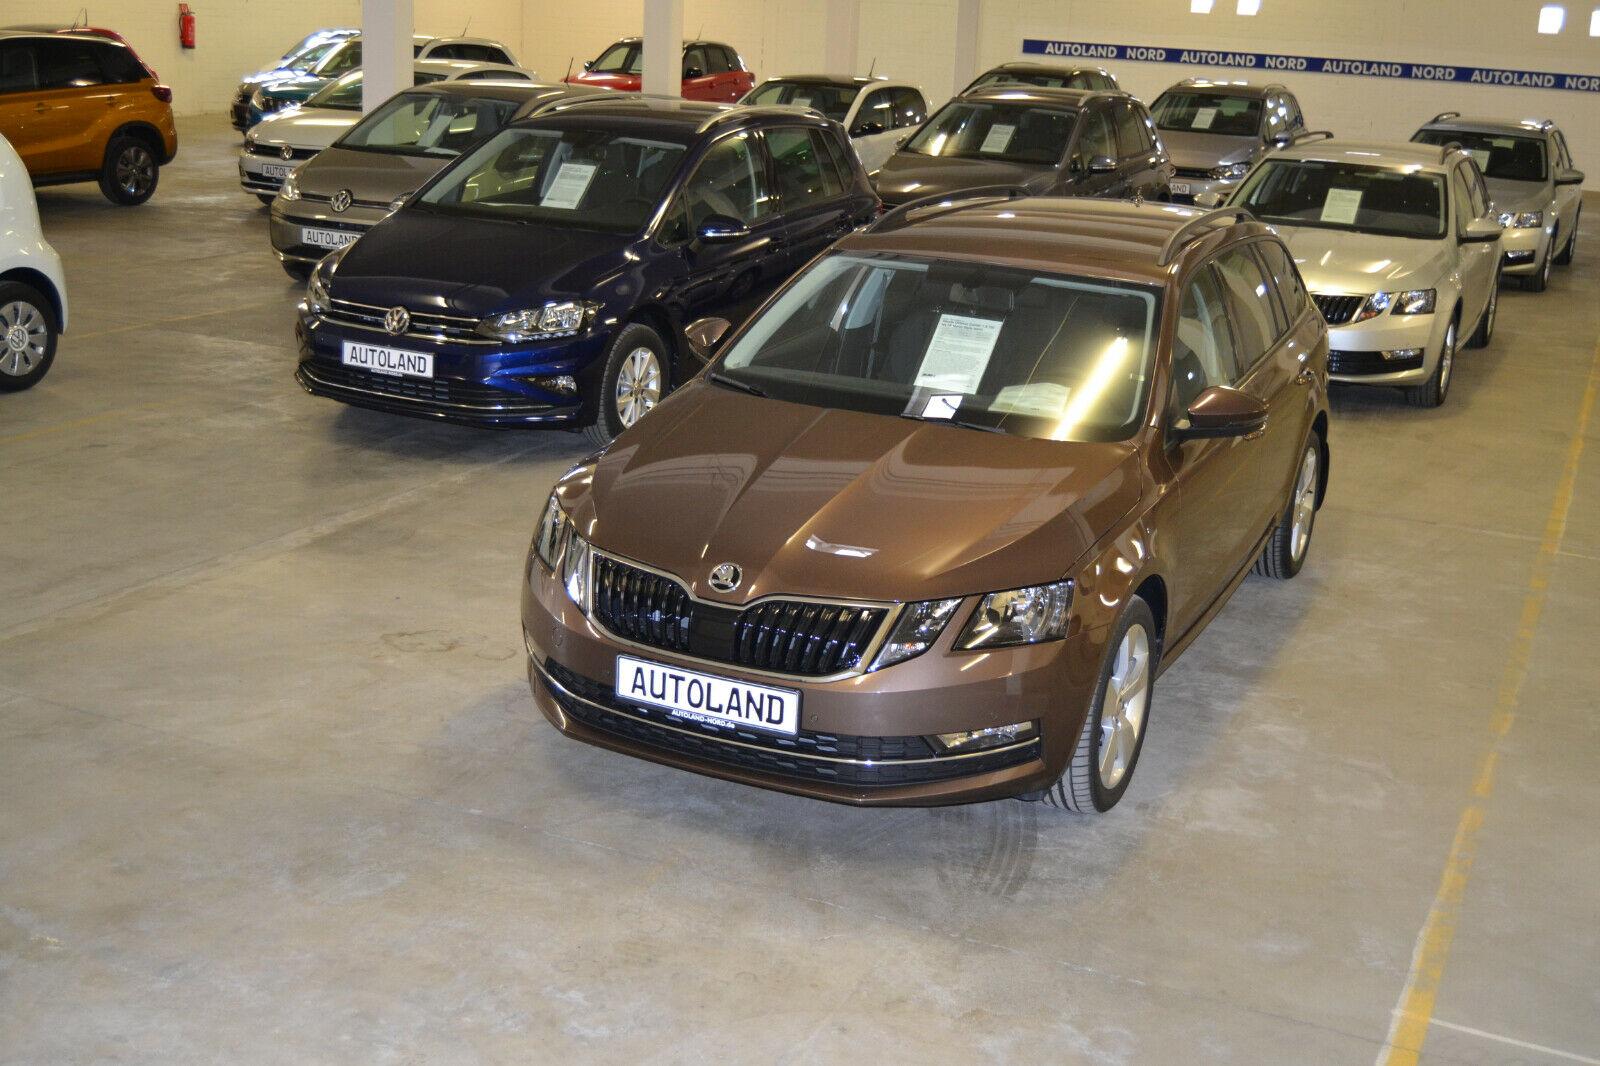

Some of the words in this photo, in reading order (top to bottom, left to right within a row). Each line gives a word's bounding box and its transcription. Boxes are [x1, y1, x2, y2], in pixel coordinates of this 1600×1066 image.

[1045, 42, 1117, 59] AUTOLAND
[1126, 47, 1166, 62] NORD
[1181, 50, 1256, 67] AUTOLAND
[1265, 56, 1307, 71] NORD
[1322, 59, 1402, 77] AUTOLAND
[1411, 65, 1456, 81] NORD
[1470, 70, 1555, 88] AUTOLAND
[265, 165, 293, 177] AUTOL
[350, 345, 427, 374] AUTOLAND
[631, 666, 785, 725] AUTOLAND
